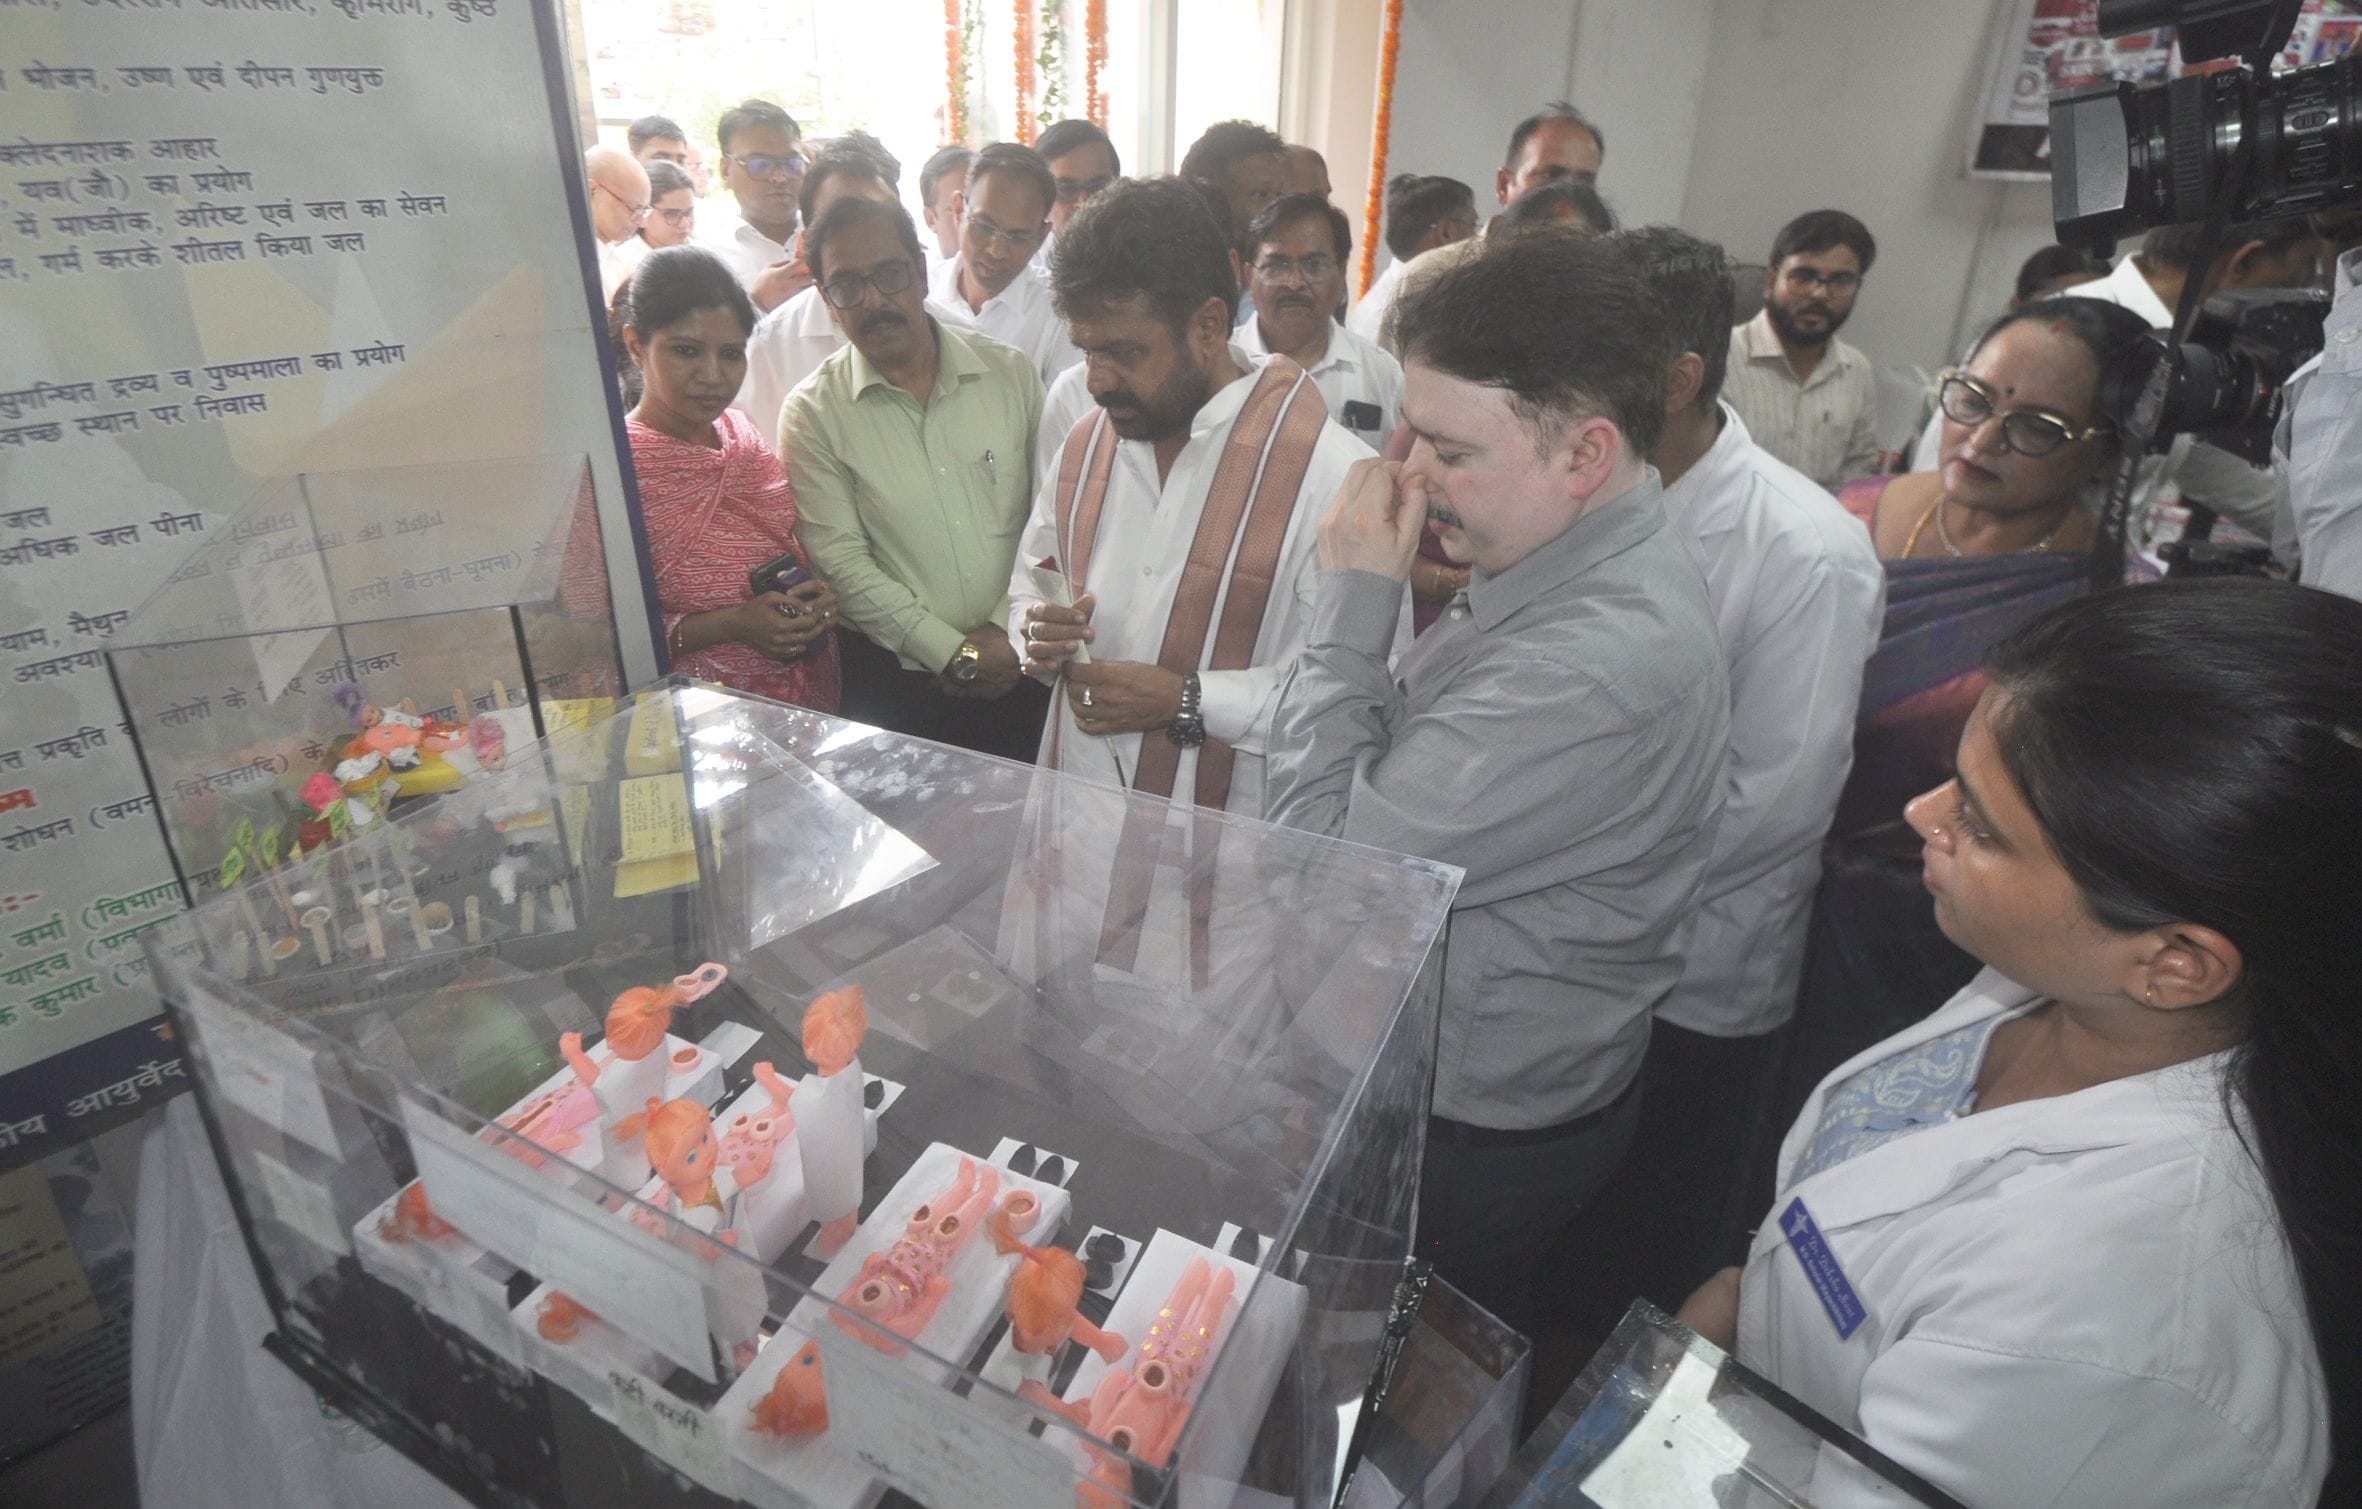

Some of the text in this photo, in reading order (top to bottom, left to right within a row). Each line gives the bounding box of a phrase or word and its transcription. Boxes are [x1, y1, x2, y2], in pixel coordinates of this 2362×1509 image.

[116, 67, 175, 88] उष्ण
[184, 61, 226, 92] एवं
[235, 60, 296, 90] दीपन
[305, 67, 385, 94] गुणयुक्त
[150, 138, 220, 160] आहार
[144, 175, 180, 195] का
[190, 164, 252, 193] प्रयोग
[14, 211, 40, 239] में
[176, 201, 248, 228] अरिष्ट
[256, 198, 294, 227] एवं
[304, 201, 348, 220] जल
[357, 199, 388, 218] का
[396, 190, 448, 216] सेवन
[38, 245, 83, 274] गर्म
[94, 240, 161, 269] करके
[170, 237, 245, 265] शीतल
[256, 232, 314, 257] किया
[322, 232, 366, 252] जल
[108, 374, 160, 399] द्रव्य
[169, 370, 191, 389] व
[204, 357, 302, 392] पुष्पमाला
[311, 352, 342, 372] का
[351, 340, 407, 366] प्रयोग
[74, 410, 140, 438] स्थान
[149, 405, 183, 426] पर
[197, 392, 268, 420] निवास
[0, 506, 51, 530] जल
[89, 524, 141, 548] जल
[150, 512, 205, 536] पीना
[68, 610, 129, 638] मैथुन
[34, 726, 107, 758] प्रकृति
[156, 696, 212, 728] लोगों
[225, 689, 247, 712] के
[301, 741, 324, 762] के
[12, 913, 65, 948] वर्मा
[0, 952, 70, 987] यादव
[26, 976, 101, 1017] कुमार
[67, 1058, 188, 1117] आयुर्वेद
